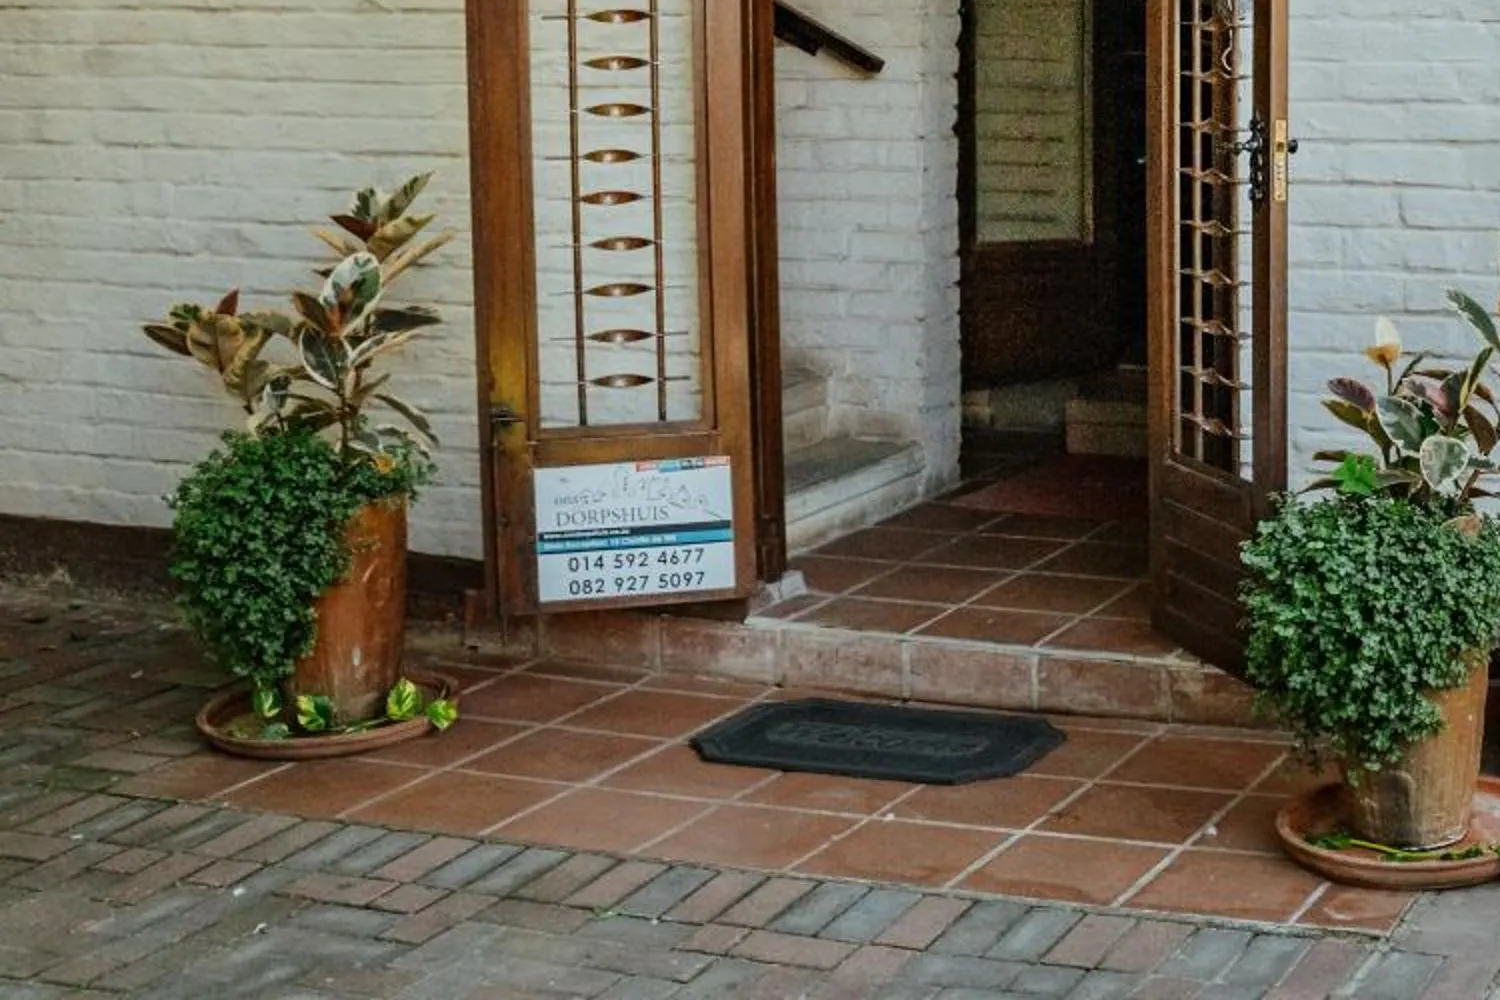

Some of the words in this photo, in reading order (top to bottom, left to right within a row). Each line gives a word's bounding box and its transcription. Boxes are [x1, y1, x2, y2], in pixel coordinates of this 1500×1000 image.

[556, 504, 669, 527] DORPSHUIS
[568, 555, 604, 573] 014
[613, 552, 649, 569] 592
[657, 548, 705, 566] 4677
[569, 579, 605, 596] 082
[615, 575, 649, 592] 927
[658, 571, 705, 590] 5097
